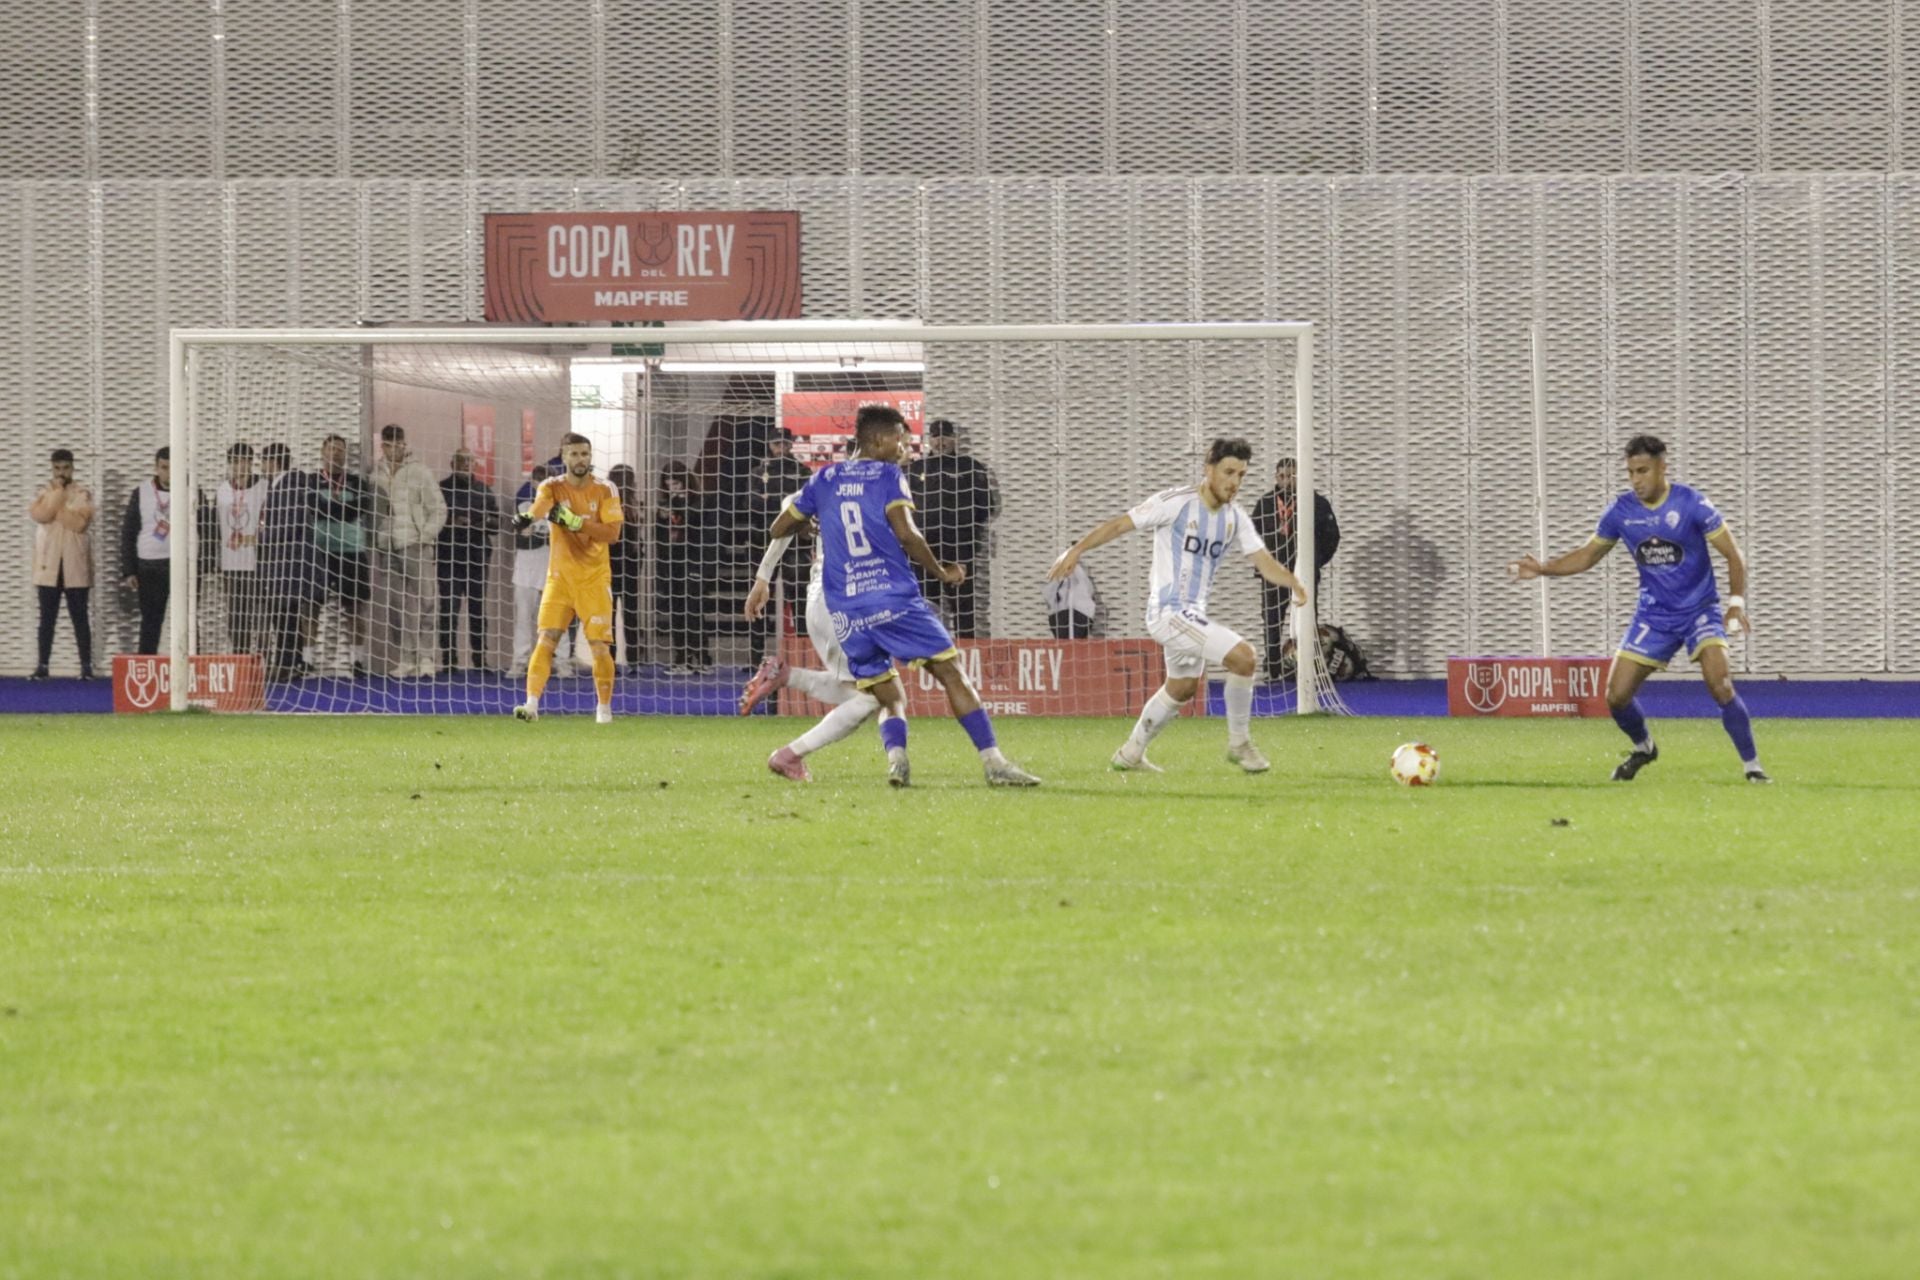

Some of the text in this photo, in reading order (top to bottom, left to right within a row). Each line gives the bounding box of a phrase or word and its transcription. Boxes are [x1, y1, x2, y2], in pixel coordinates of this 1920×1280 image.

[548, 224, 735, 278] COPA DEL REY
[595, 291, 688, 306] MAPFRE
[836, 483, 864, 497] JERIN
[841, 501, 872, 557] 8
[1634, 622, 1650, 644] 7
[159, 662, 235, 693] CA REY
[1018, 649, 1063, 691] REY
[1508, 667, 1553, 698] COPA
[1568, 667, 1600, 698] REY
[1531, 703, 1578, 713] MAPFRE
